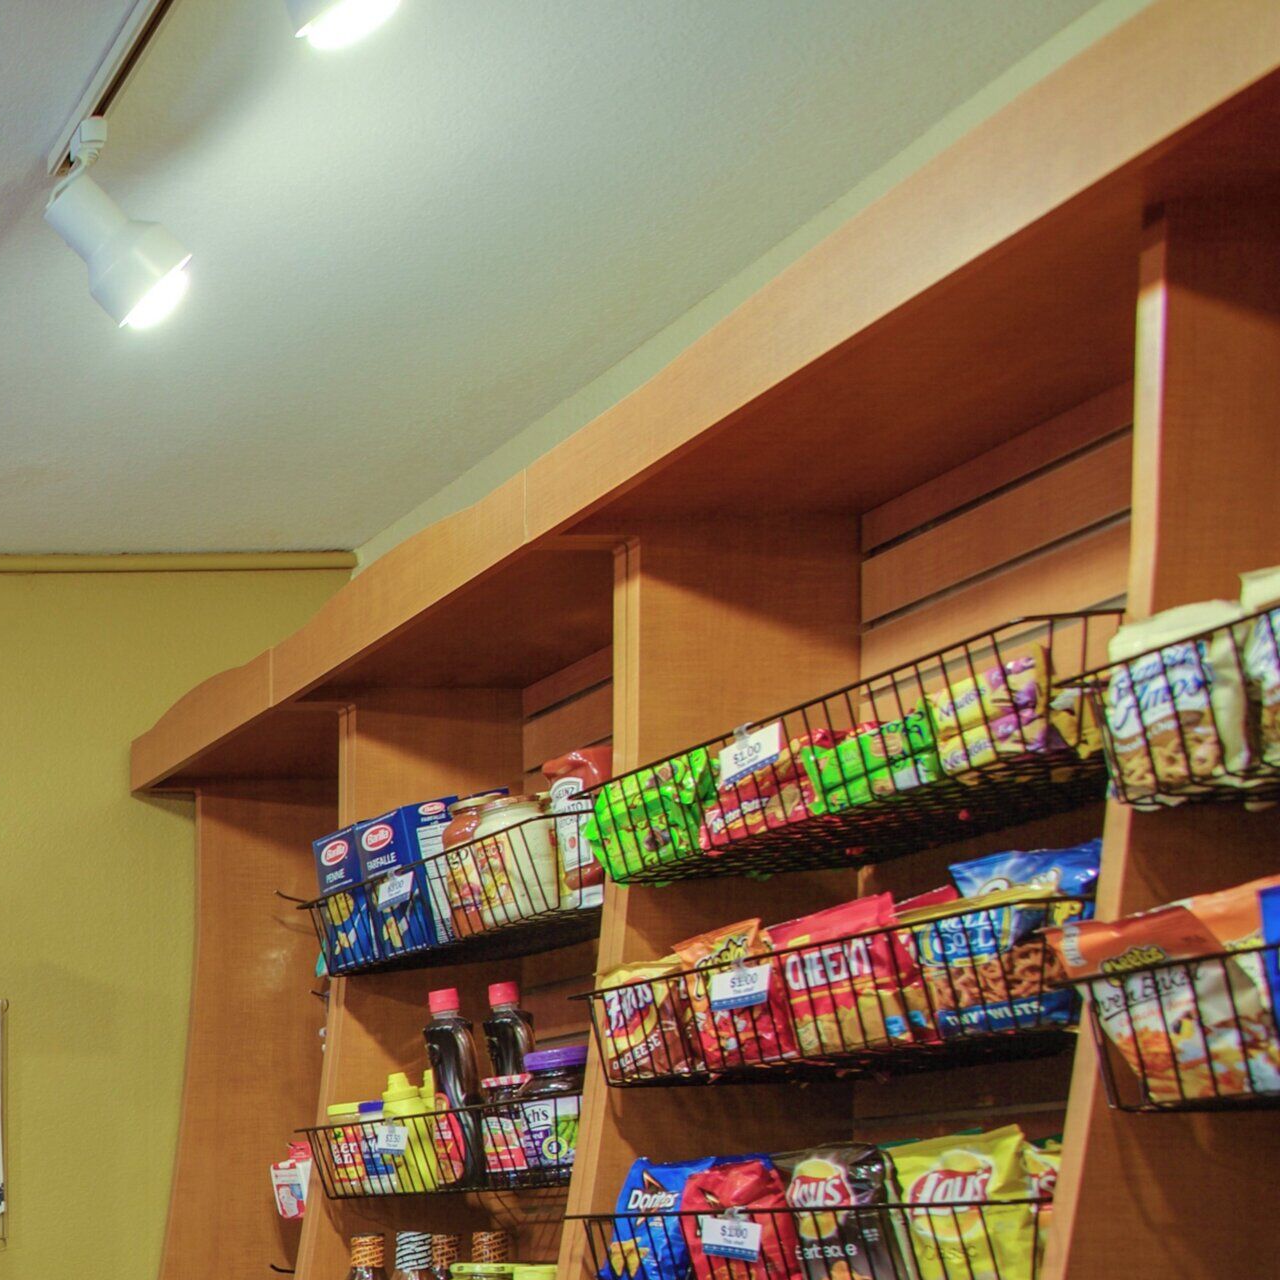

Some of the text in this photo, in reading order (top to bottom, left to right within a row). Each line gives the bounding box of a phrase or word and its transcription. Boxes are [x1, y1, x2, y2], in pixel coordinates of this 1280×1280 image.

[366, 852, 397, 872] FARFALLE
[326, 868, 345, 885] PENNE
[627, 1189, 679, 1210] Doritos
